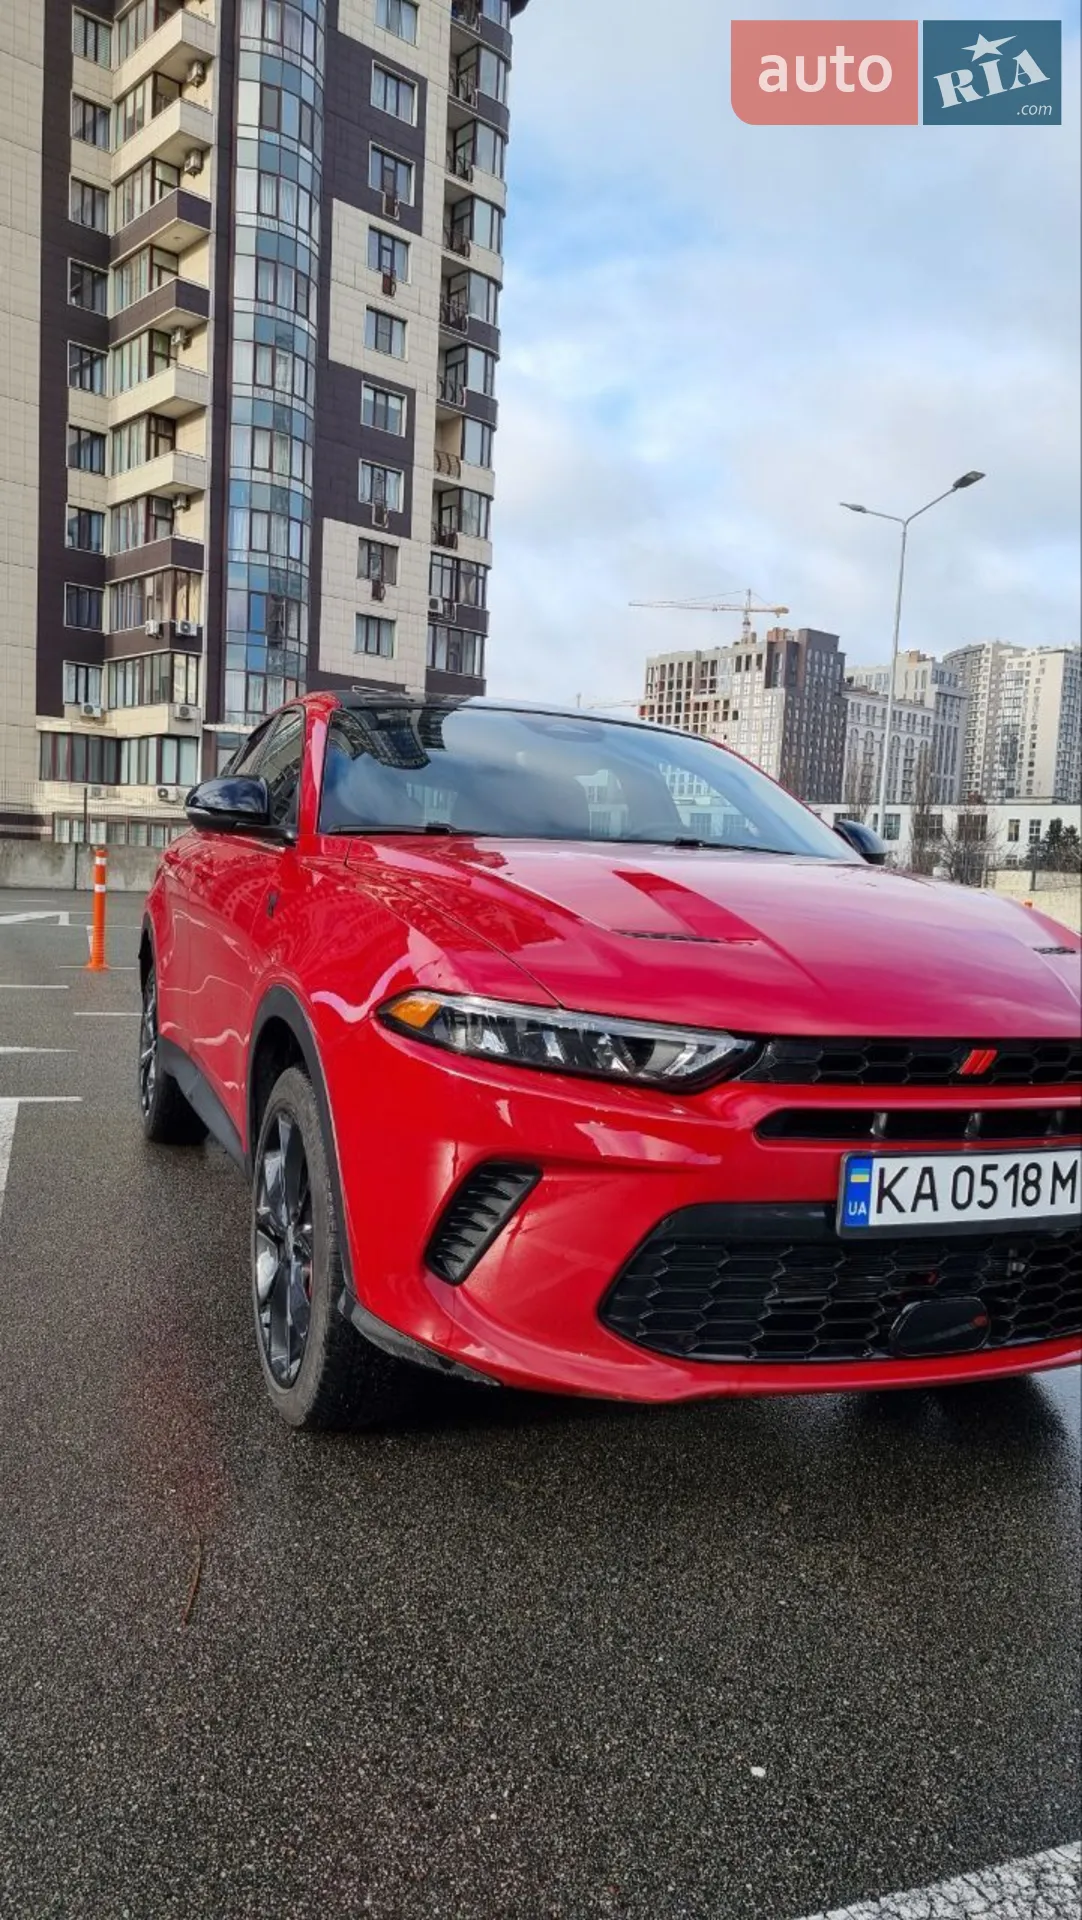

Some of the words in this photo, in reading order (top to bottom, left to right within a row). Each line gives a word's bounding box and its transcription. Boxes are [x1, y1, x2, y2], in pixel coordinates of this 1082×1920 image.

[876, 1166, 939, 1214] KA
[951, 1162, 1042, 1210] 0518
[1050, 1159, 1079, 1205] M
[848, 1201, 868, 1216] UA
